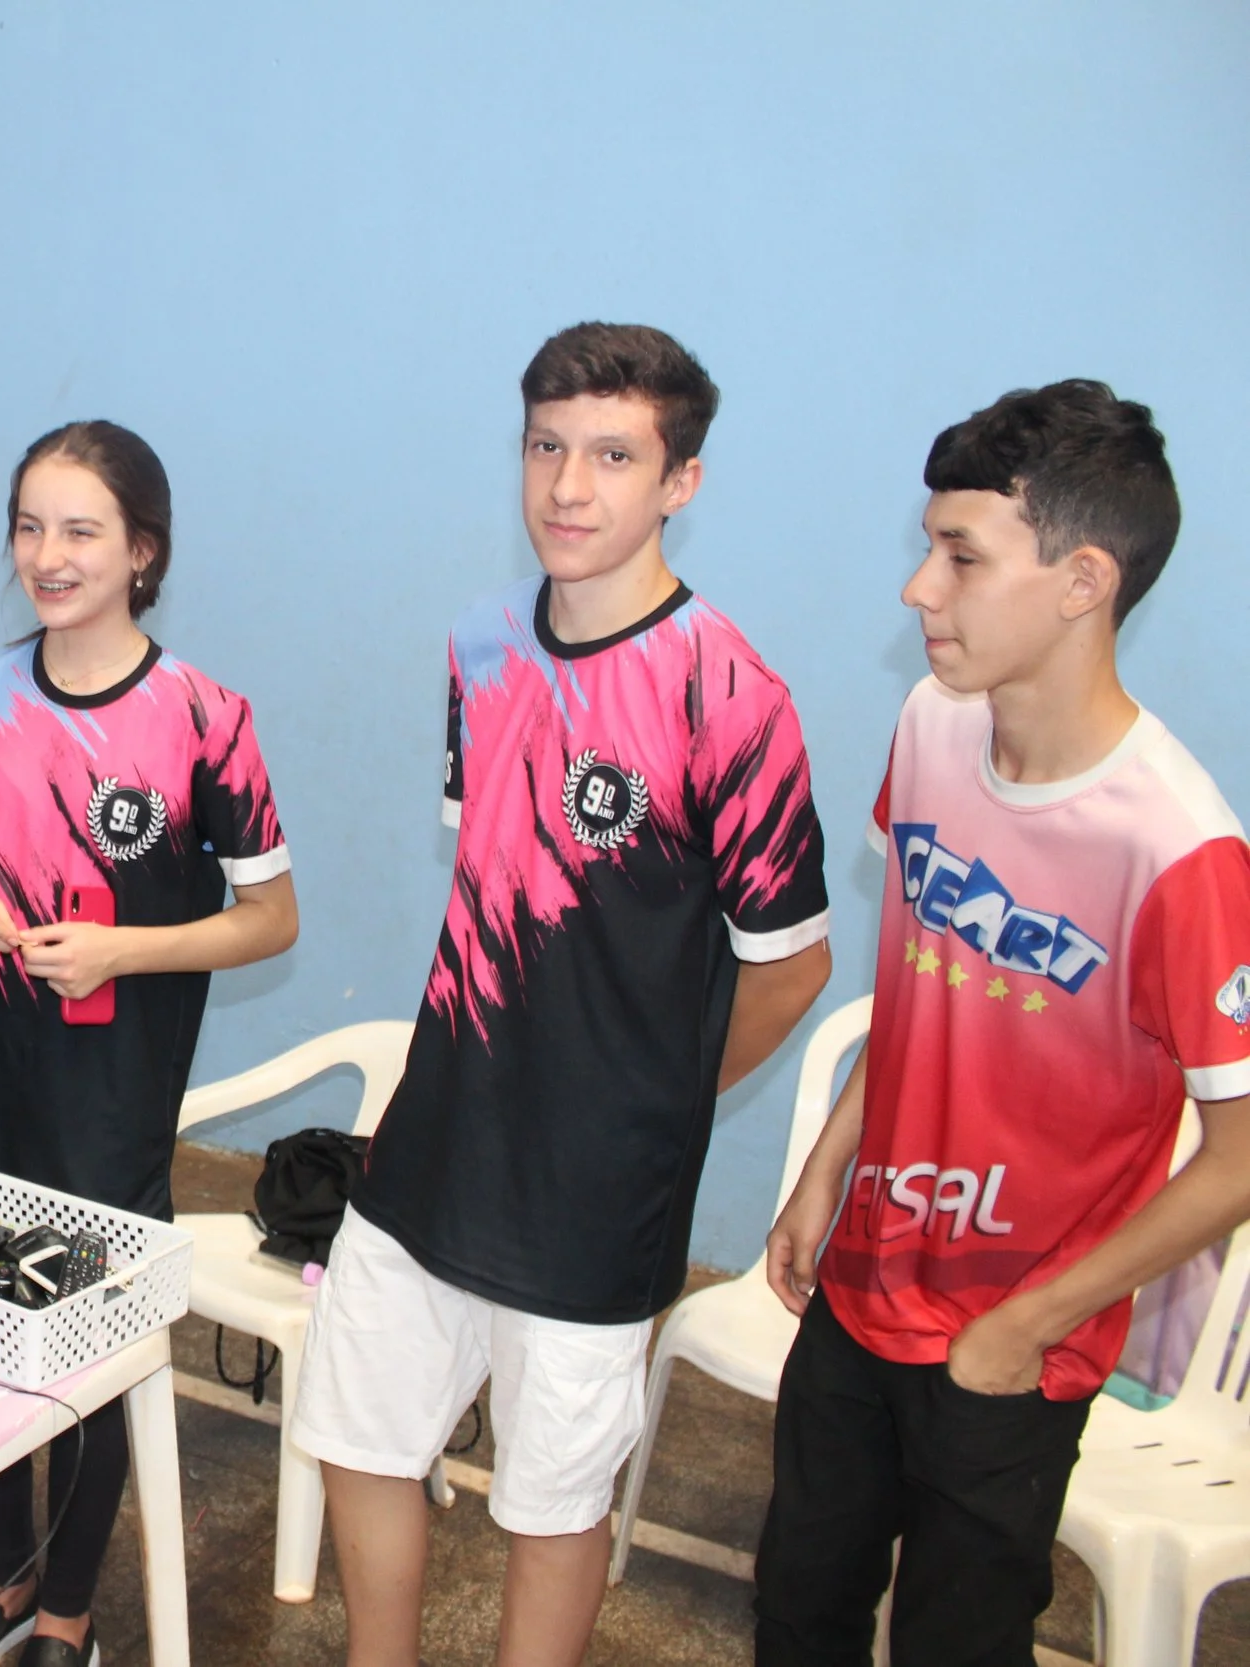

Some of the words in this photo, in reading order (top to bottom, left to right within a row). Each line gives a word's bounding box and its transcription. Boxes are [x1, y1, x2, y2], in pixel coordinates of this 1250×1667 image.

[597, 806, 615, 820] ANO
[900, 832, 1110, 986] CEART
[848, 1161, 1014, 1242] FSAL
